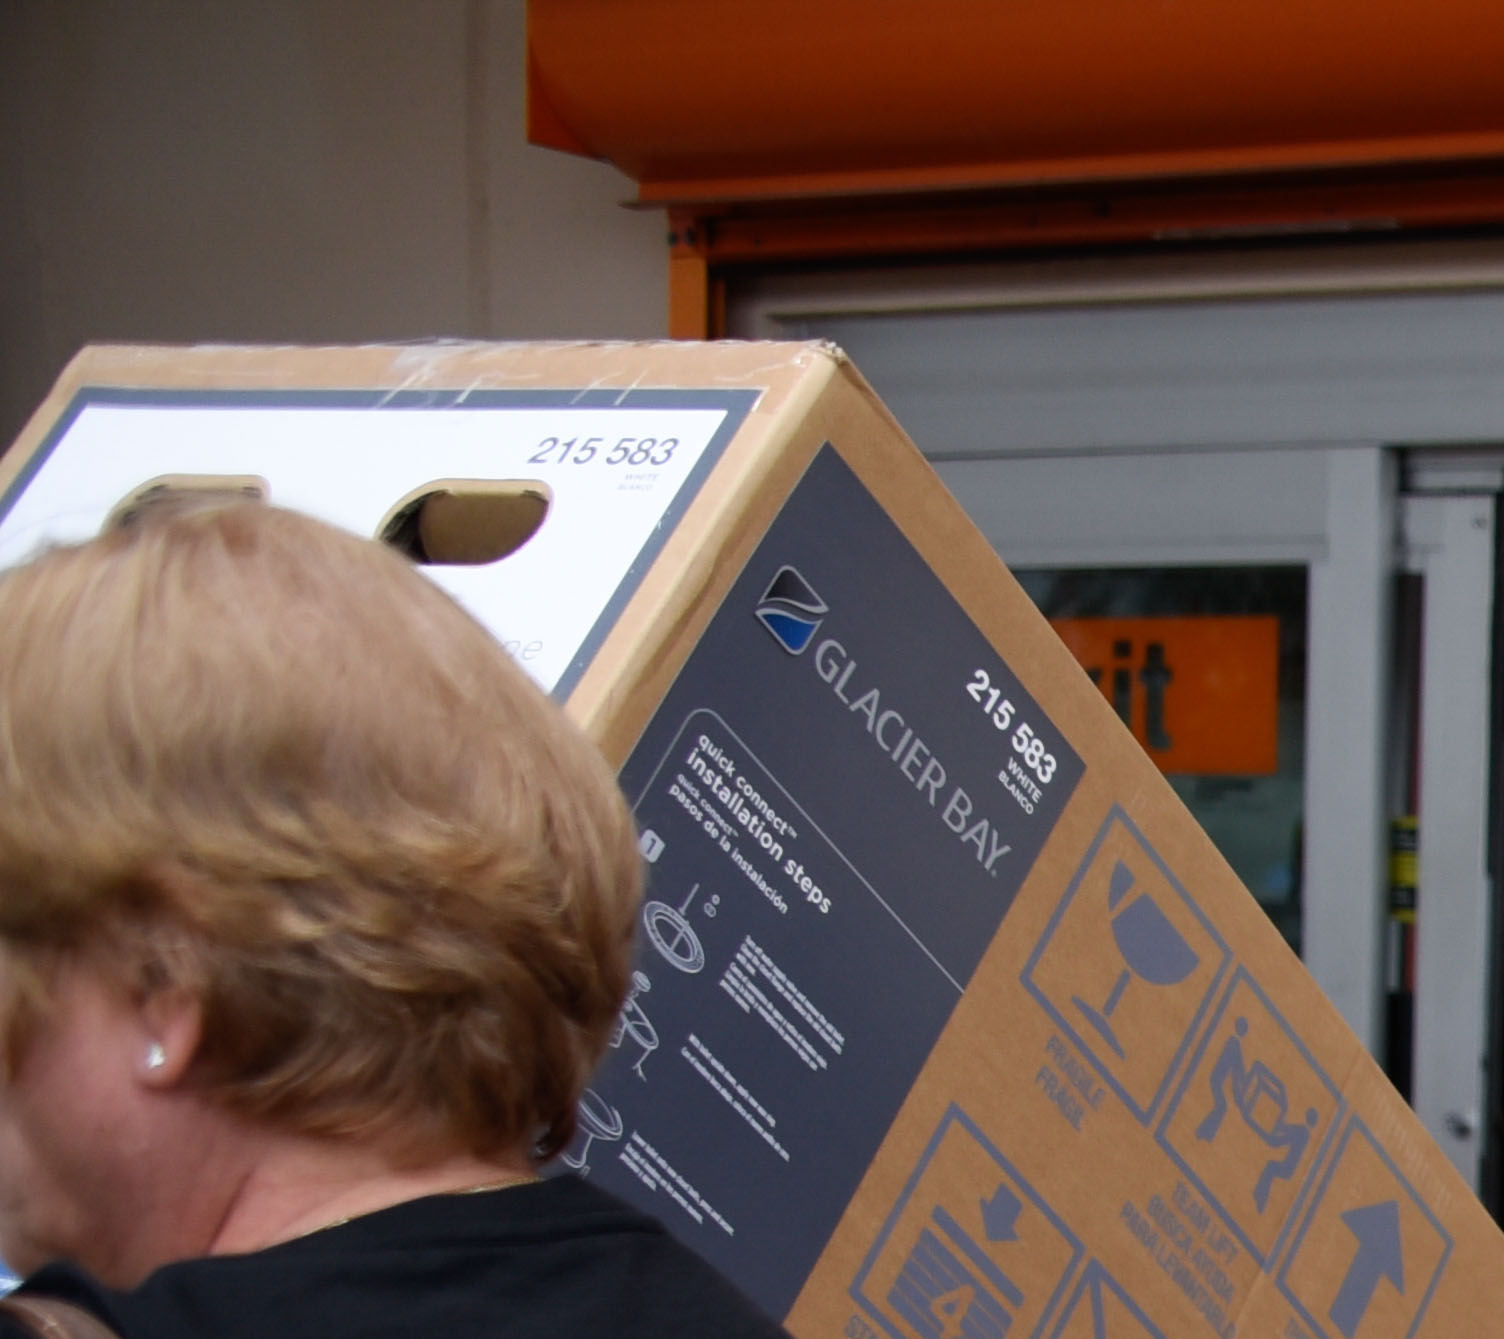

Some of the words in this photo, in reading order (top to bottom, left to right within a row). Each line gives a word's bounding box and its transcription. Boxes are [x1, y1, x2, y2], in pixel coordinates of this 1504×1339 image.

[527, 437, 604, 465] 215
[606, 437, 679, 465] 583
[699, 734, 736, 777] quick
[815, 639, 947, 807] GLACIER
[942, 786, 1012, 871] BAY
[966, 668, 1015, 731] 215
[1012, 722, 1057, 784] 583
[677, 773, 701, 800] quick
[998, 770, 1034, 815] BLANCO
[1007, 756, 1043, 804] WHITE
[669, 783, 703, 821] pasos
[703, 819, 719, 839] de
[719, 835, 731, 852] la
[731, 848, 788, 914] instalación
[687, 748, 784, 861] installation
[784, 859, 832, 914] steps
[1035, 1064, 1085, 1133] FRAGIL
[1045, 1034, 1106, 1112] FRAGILE
